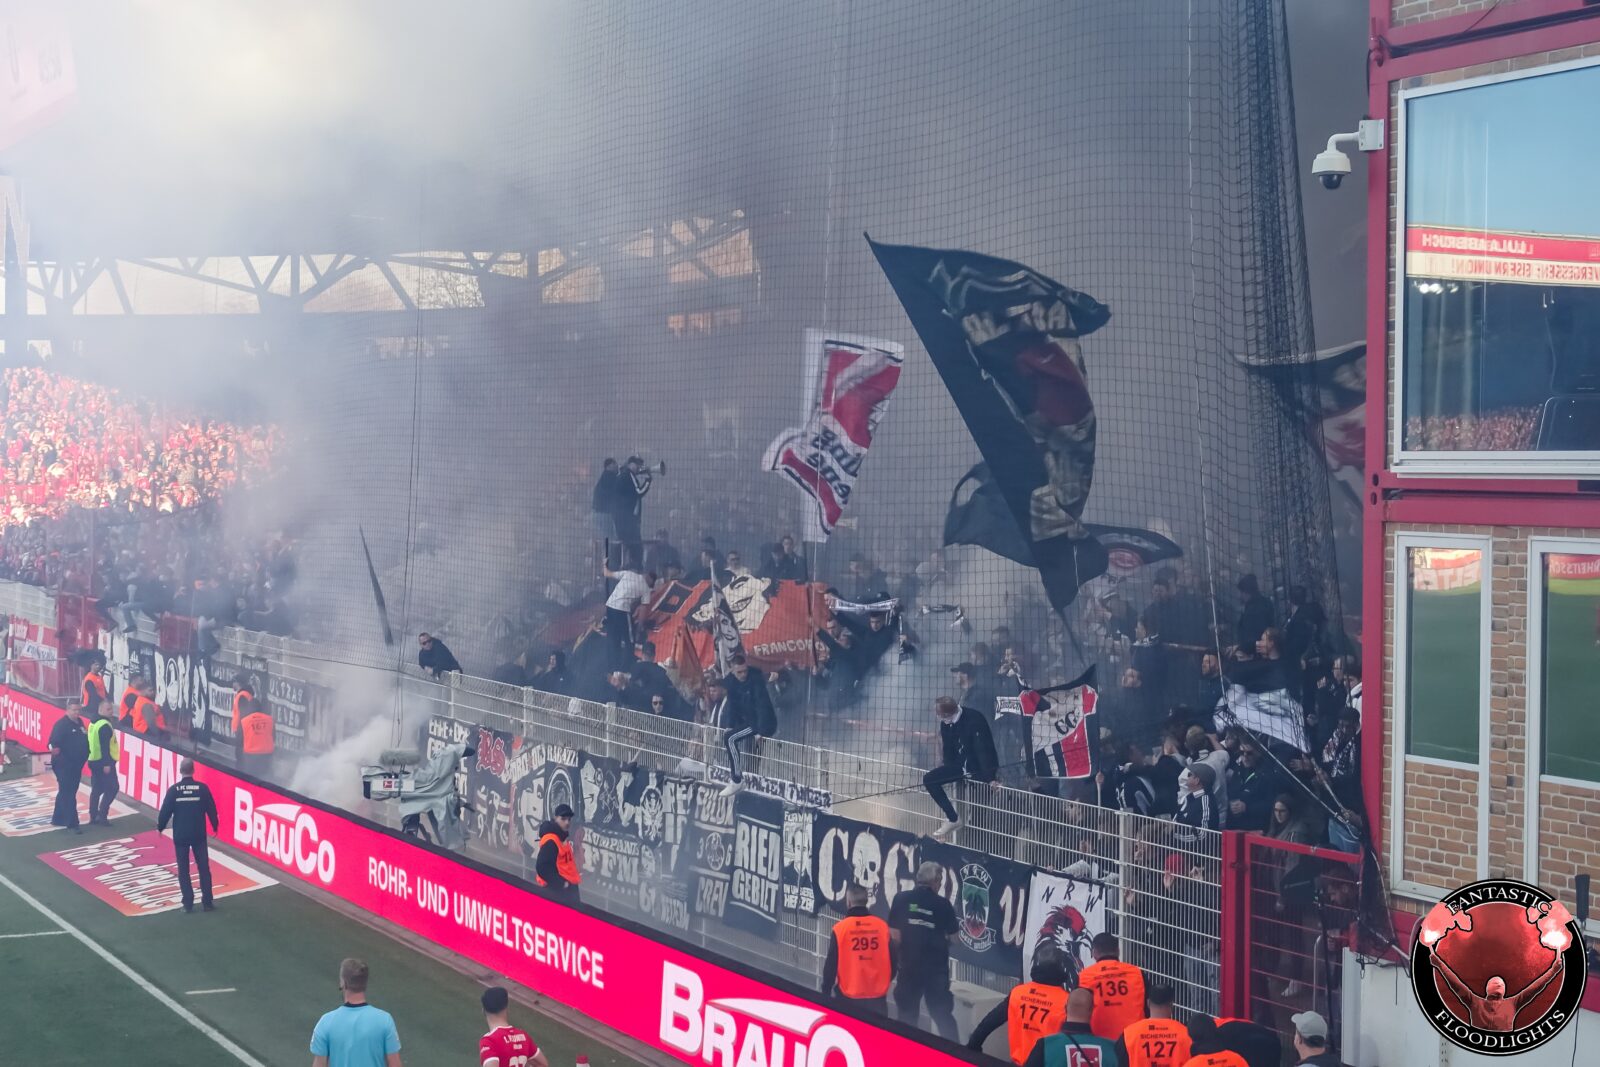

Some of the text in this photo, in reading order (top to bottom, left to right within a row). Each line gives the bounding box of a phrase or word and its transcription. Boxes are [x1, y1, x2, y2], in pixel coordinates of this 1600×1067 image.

[113, 728, 184, 811] LTEN
[582, 845, 640, 886] FFM
[734, 821, 781, 881] RIED
[369, 856, 605, 990] ROHR- UND UMWELTSERVICE
[851, 937, 879, 951] 295
[1095, 980, 1129, 998] 136
[1019, 1003, 1050, 1025] 177
[1142, 1041, 1177, 1058] 127
